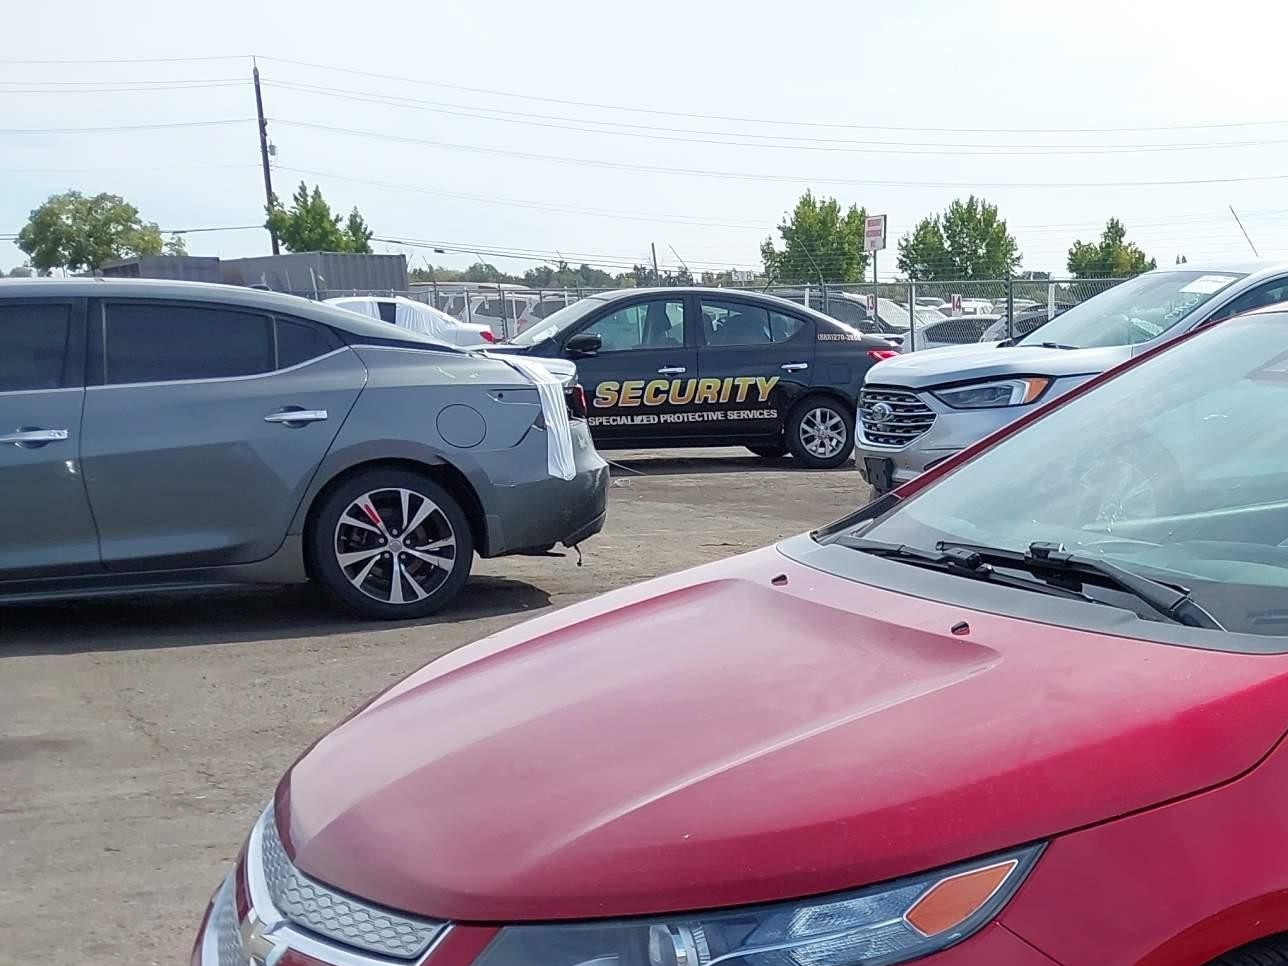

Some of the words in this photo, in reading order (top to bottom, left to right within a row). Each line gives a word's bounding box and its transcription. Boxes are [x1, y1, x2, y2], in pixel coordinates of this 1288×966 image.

[951, 295, 962, 311] 14
[593, 376, 780, 407] SECURITY
[587, 413, 659, 426] SPECIALIZED
[660, 410, 726, 424] PROTECTIVE
[726, 408, 778, 420] SERVICES
